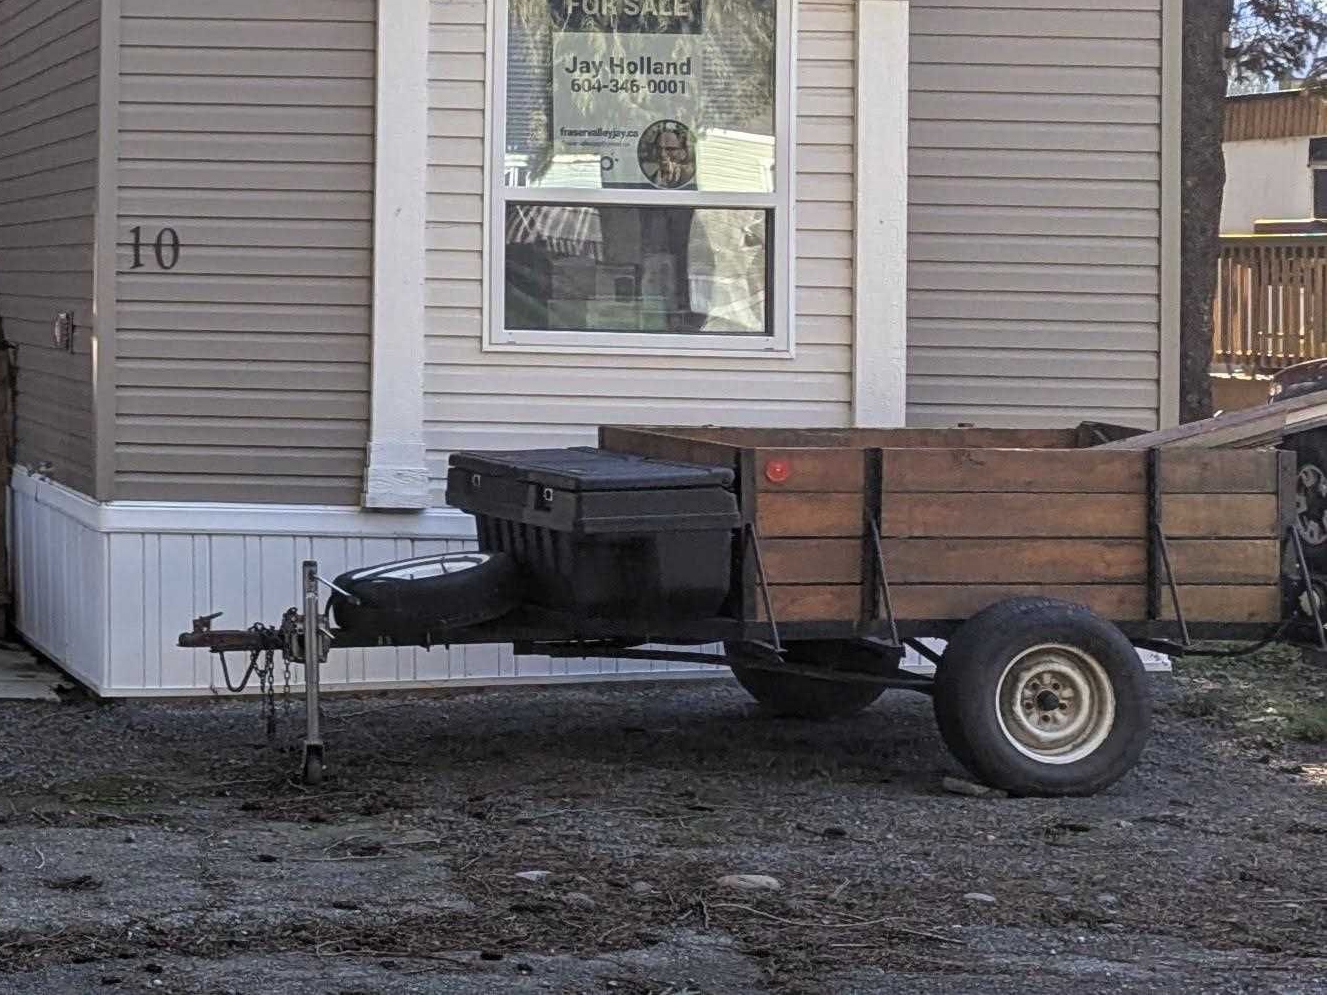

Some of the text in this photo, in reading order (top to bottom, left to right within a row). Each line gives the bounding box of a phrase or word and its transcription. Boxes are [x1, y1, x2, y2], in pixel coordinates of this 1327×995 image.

[565, 56, 692, 78] Jay Holland
[570, 78, 686, 94] 604-346-0001
[129, 226, 180, 270] 10
